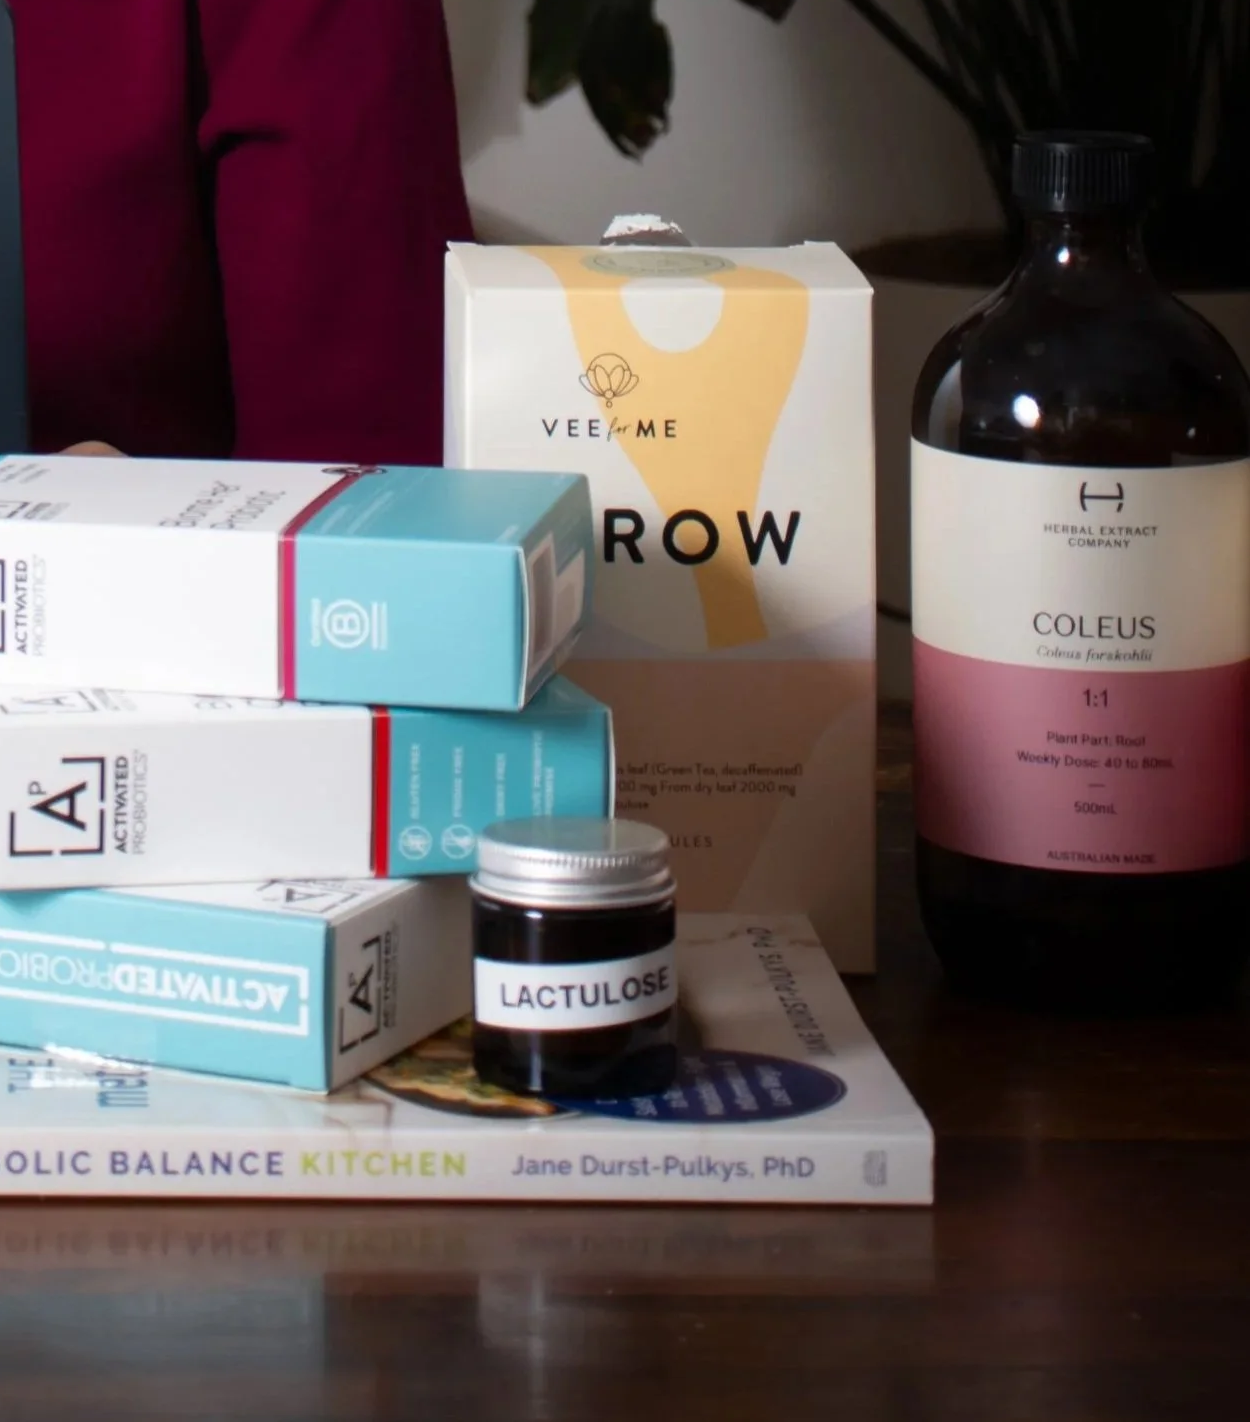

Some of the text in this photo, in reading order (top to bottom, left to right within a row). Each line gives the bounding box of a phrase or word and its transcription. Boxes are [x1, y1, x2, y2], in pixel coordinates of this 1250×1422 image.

[541, 416, 678, 442] VEE for ME
[603, 508, 800, 566] ROW
[1043, 523, 1158, 537] HERBAL EXTRACT
[1067, 537, 1131, 549] COMPANY
[15, 560, 28, 654] ACTIVATED
[1033, 611, 1156, 640] COLEUS
[1036, 645, 1082, 661] Coleus
[1082, 688, 1109, 708] 1:1
[1047, 731, 1078, 745] Plant
[1016, 750, 1061, 768] Weekly
[1104, 757, 1122, 769] 40
[1125, 757, 1139, 769] to
[628, 763, 648, 775] leaf
[652, 763, 692, 777] (Green
[639, 784, 657, 796] mg
[660, 781, 691, 793] From
[695, 781, 713, 795] dry
[716, 781, 736, 793] leaf
[741, 782, 775, 793] 2000
[778, 784, 796, 796] mg
[114, 756, 128, 854] ACTIVATED
[1073, 801, 1118, 815] 500mL
[669, 836, 713, 848] ULES
[1047, 850, 1156, 864] AUSTRALIAN MADE
[500, 966, 670, 1010] LACTULOSE
[109, 1150, 285, 1176] BALANCE
[301, 1151, 467, 1177] KITCHEN
[512, 1153, 572, 1177] Jane
[581, 1154, 754, 1183] Durst-Pulkys,
[763, 1156, 815, 1178] PhD
